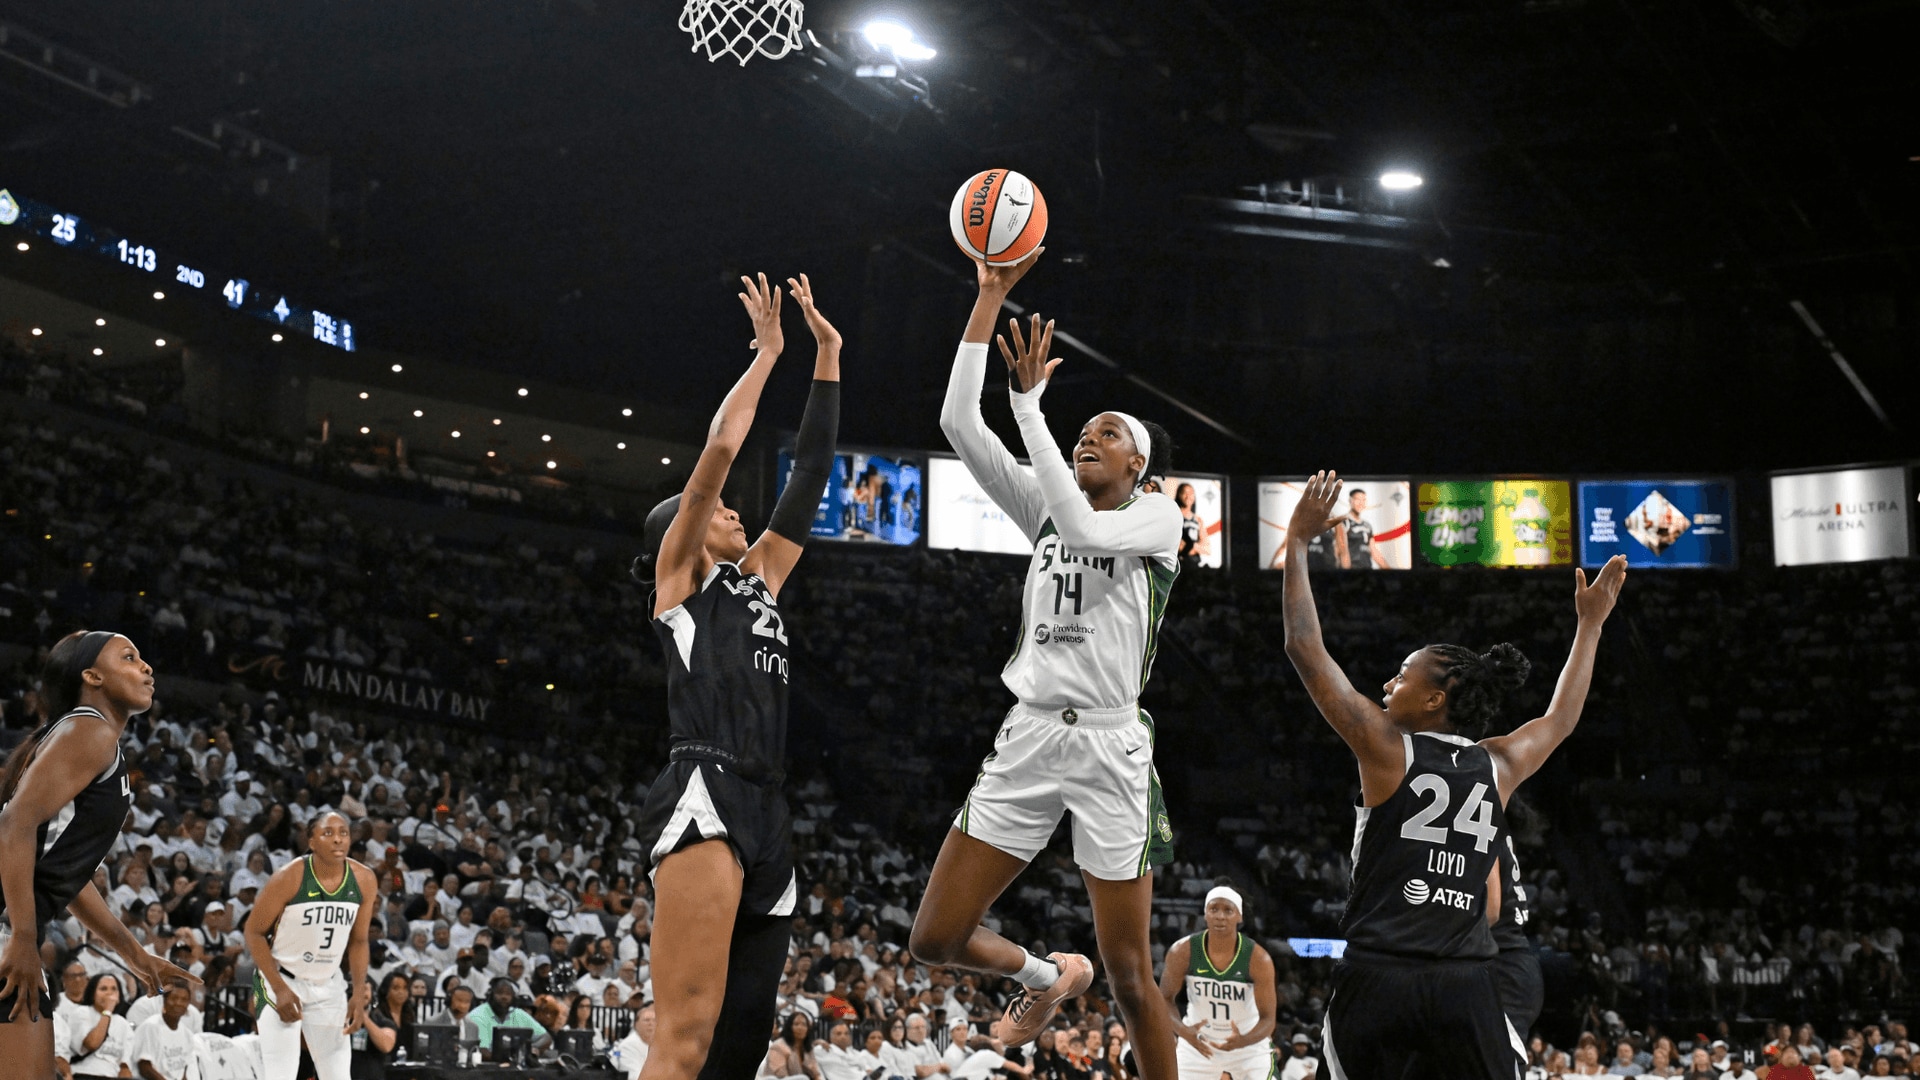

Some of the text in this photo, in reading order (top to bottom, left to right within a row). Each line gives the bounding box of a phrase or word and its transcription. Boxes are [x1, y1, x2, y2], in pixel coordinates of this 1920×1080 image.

[969, 171, 1001, 228] Wilson
[51, 213, 77, 243] 25
[117, 239, 157, 272] 1:13
[176, 264, 205, 288] 2ND
[222, 279, 243, 305] 41
[982, 511, 1005, 522] ARE
[1425, 505, 1484, 526] LEMON
[1846, 500, 1899, 514] ULTRA
[1431, 524, 1479, 548] LIME
[1817, 520, 1865, 532] ARENA
[1052, 572, 1082, 615] 14
[747, 600, 788, 646] 22
[1053, 623, 1096, 635] Providence
[1053, 635, 1086, 644] SWEDISH
[754, 646, 789, 684] ring
[303, 661, 492, 721] MANDALAY BAY
[1400, 773, 1498, 854] 24
[1427, 848, 1466, 877] LOYD
[1431, 887, 1475, 911] AT&T
[319, 927, 335, 950] 3
[1193, 981, 1246, 1002] STORM
[1208, 1000, 1230, 1020] 17
[1743, 1049, 1755, 1064] H
